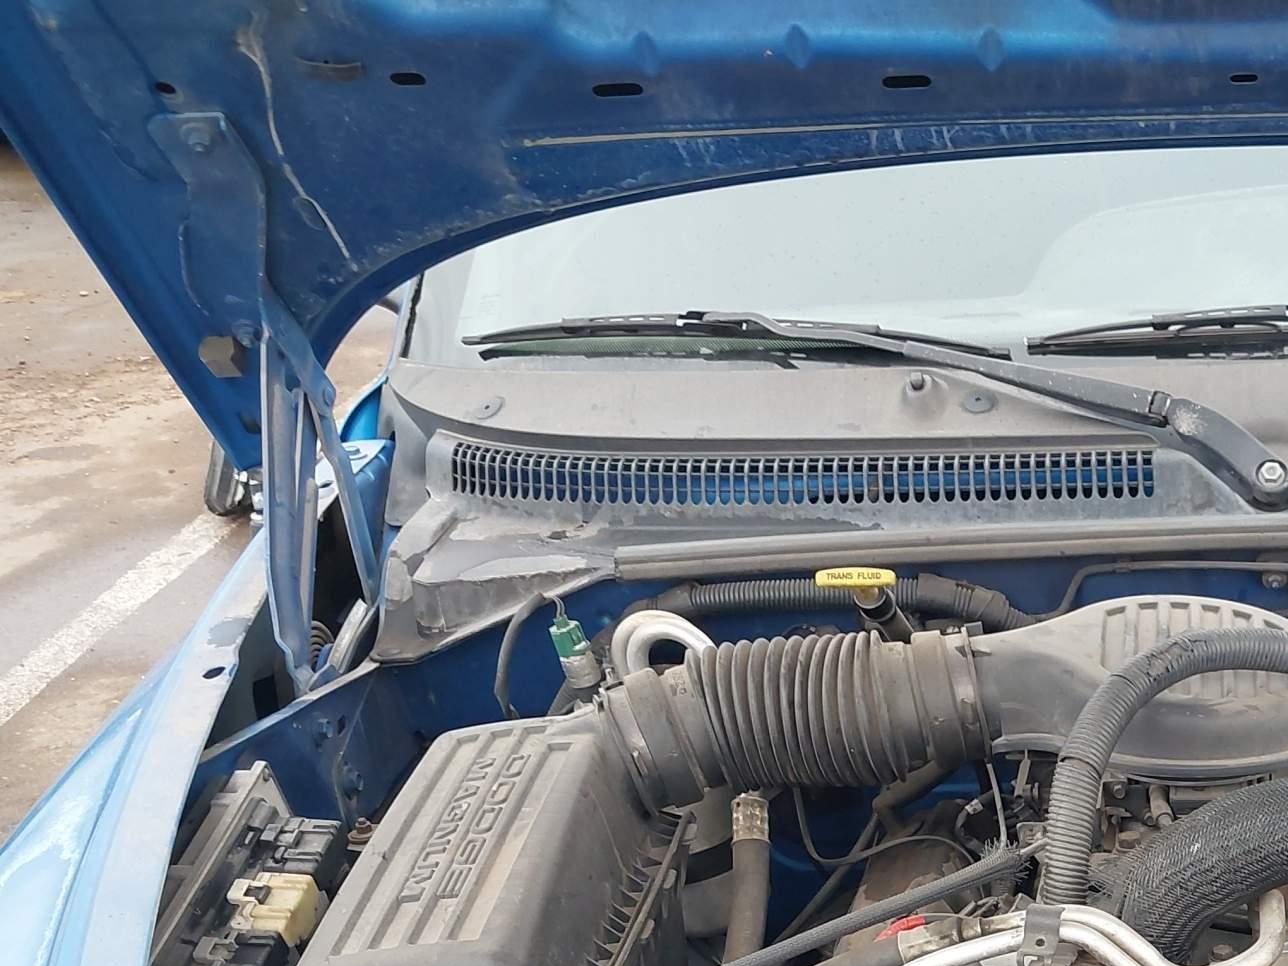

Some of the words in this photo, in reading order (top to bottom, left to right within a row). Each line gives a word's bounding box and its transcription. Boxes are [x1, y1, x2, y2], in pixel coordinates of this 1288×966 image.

[826, 572, 853, 580] TRANS
[399, 757, 494, 904] MAGNUM
[435, 753, 531, 901] DODGE
